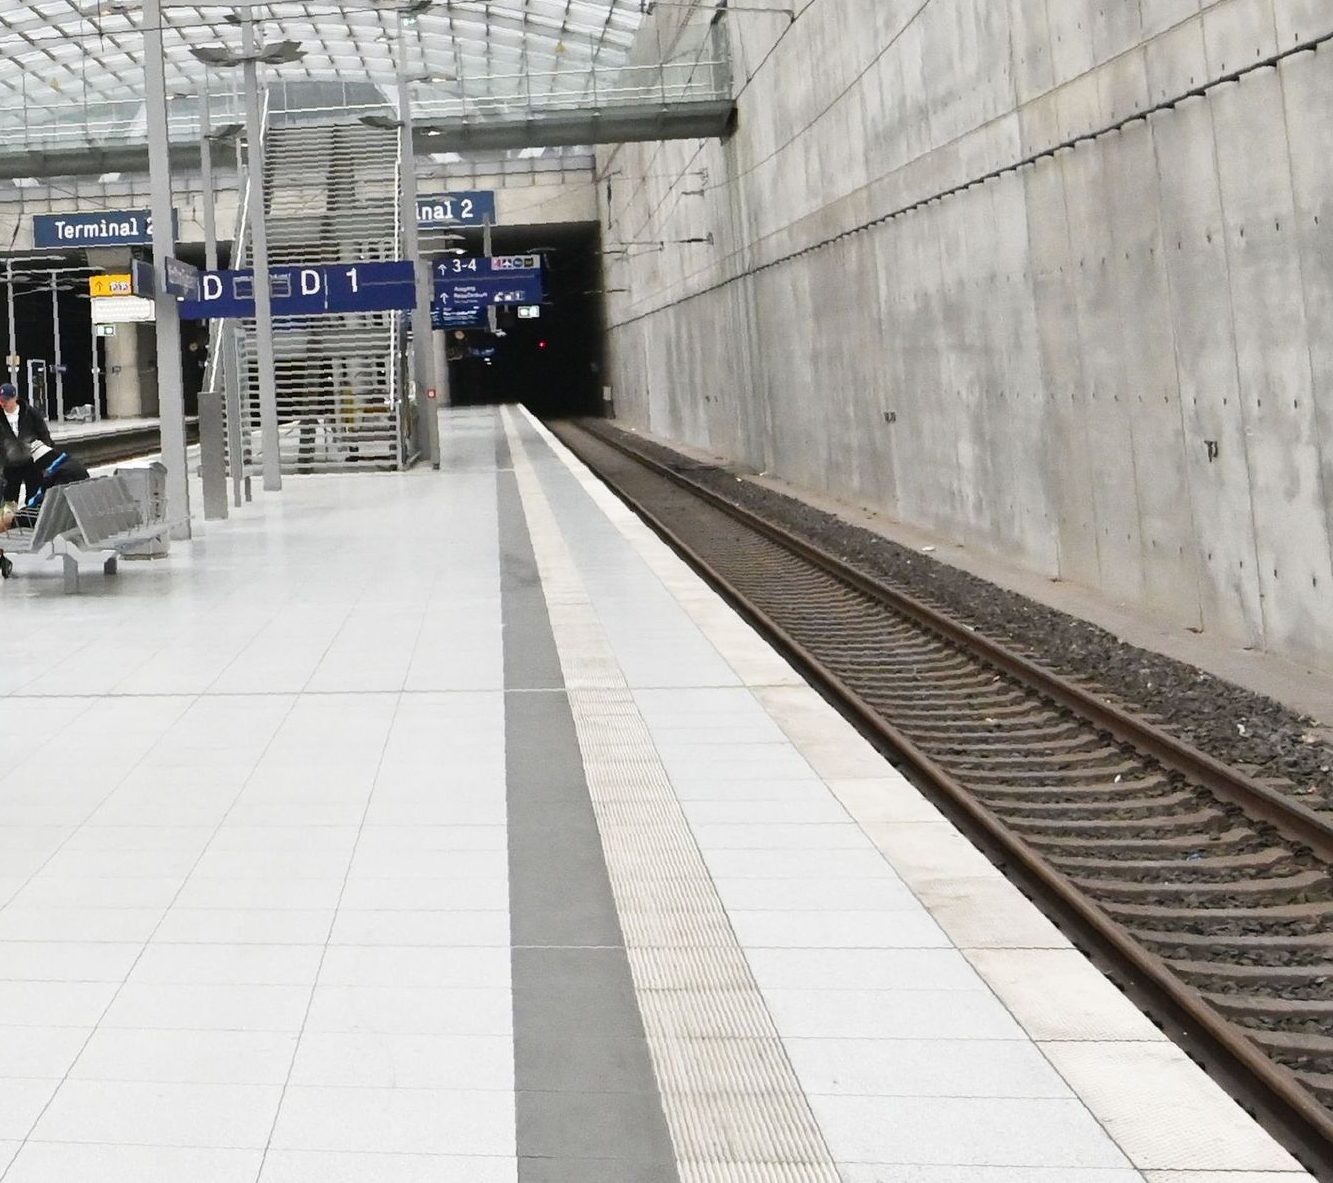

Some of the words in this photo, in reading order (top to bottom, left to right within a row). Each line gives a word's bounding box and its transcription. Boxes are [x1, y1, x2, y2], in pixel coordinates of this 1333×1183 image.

[460, 198, 474, 219] 2
[54, 218, 139, 240] Terminal
[452, 258, 477, 273] 3-4
[202, 274, 223, 301] D
[300, 269, 322, 296] D
[346, 267, 359, 293] 1
